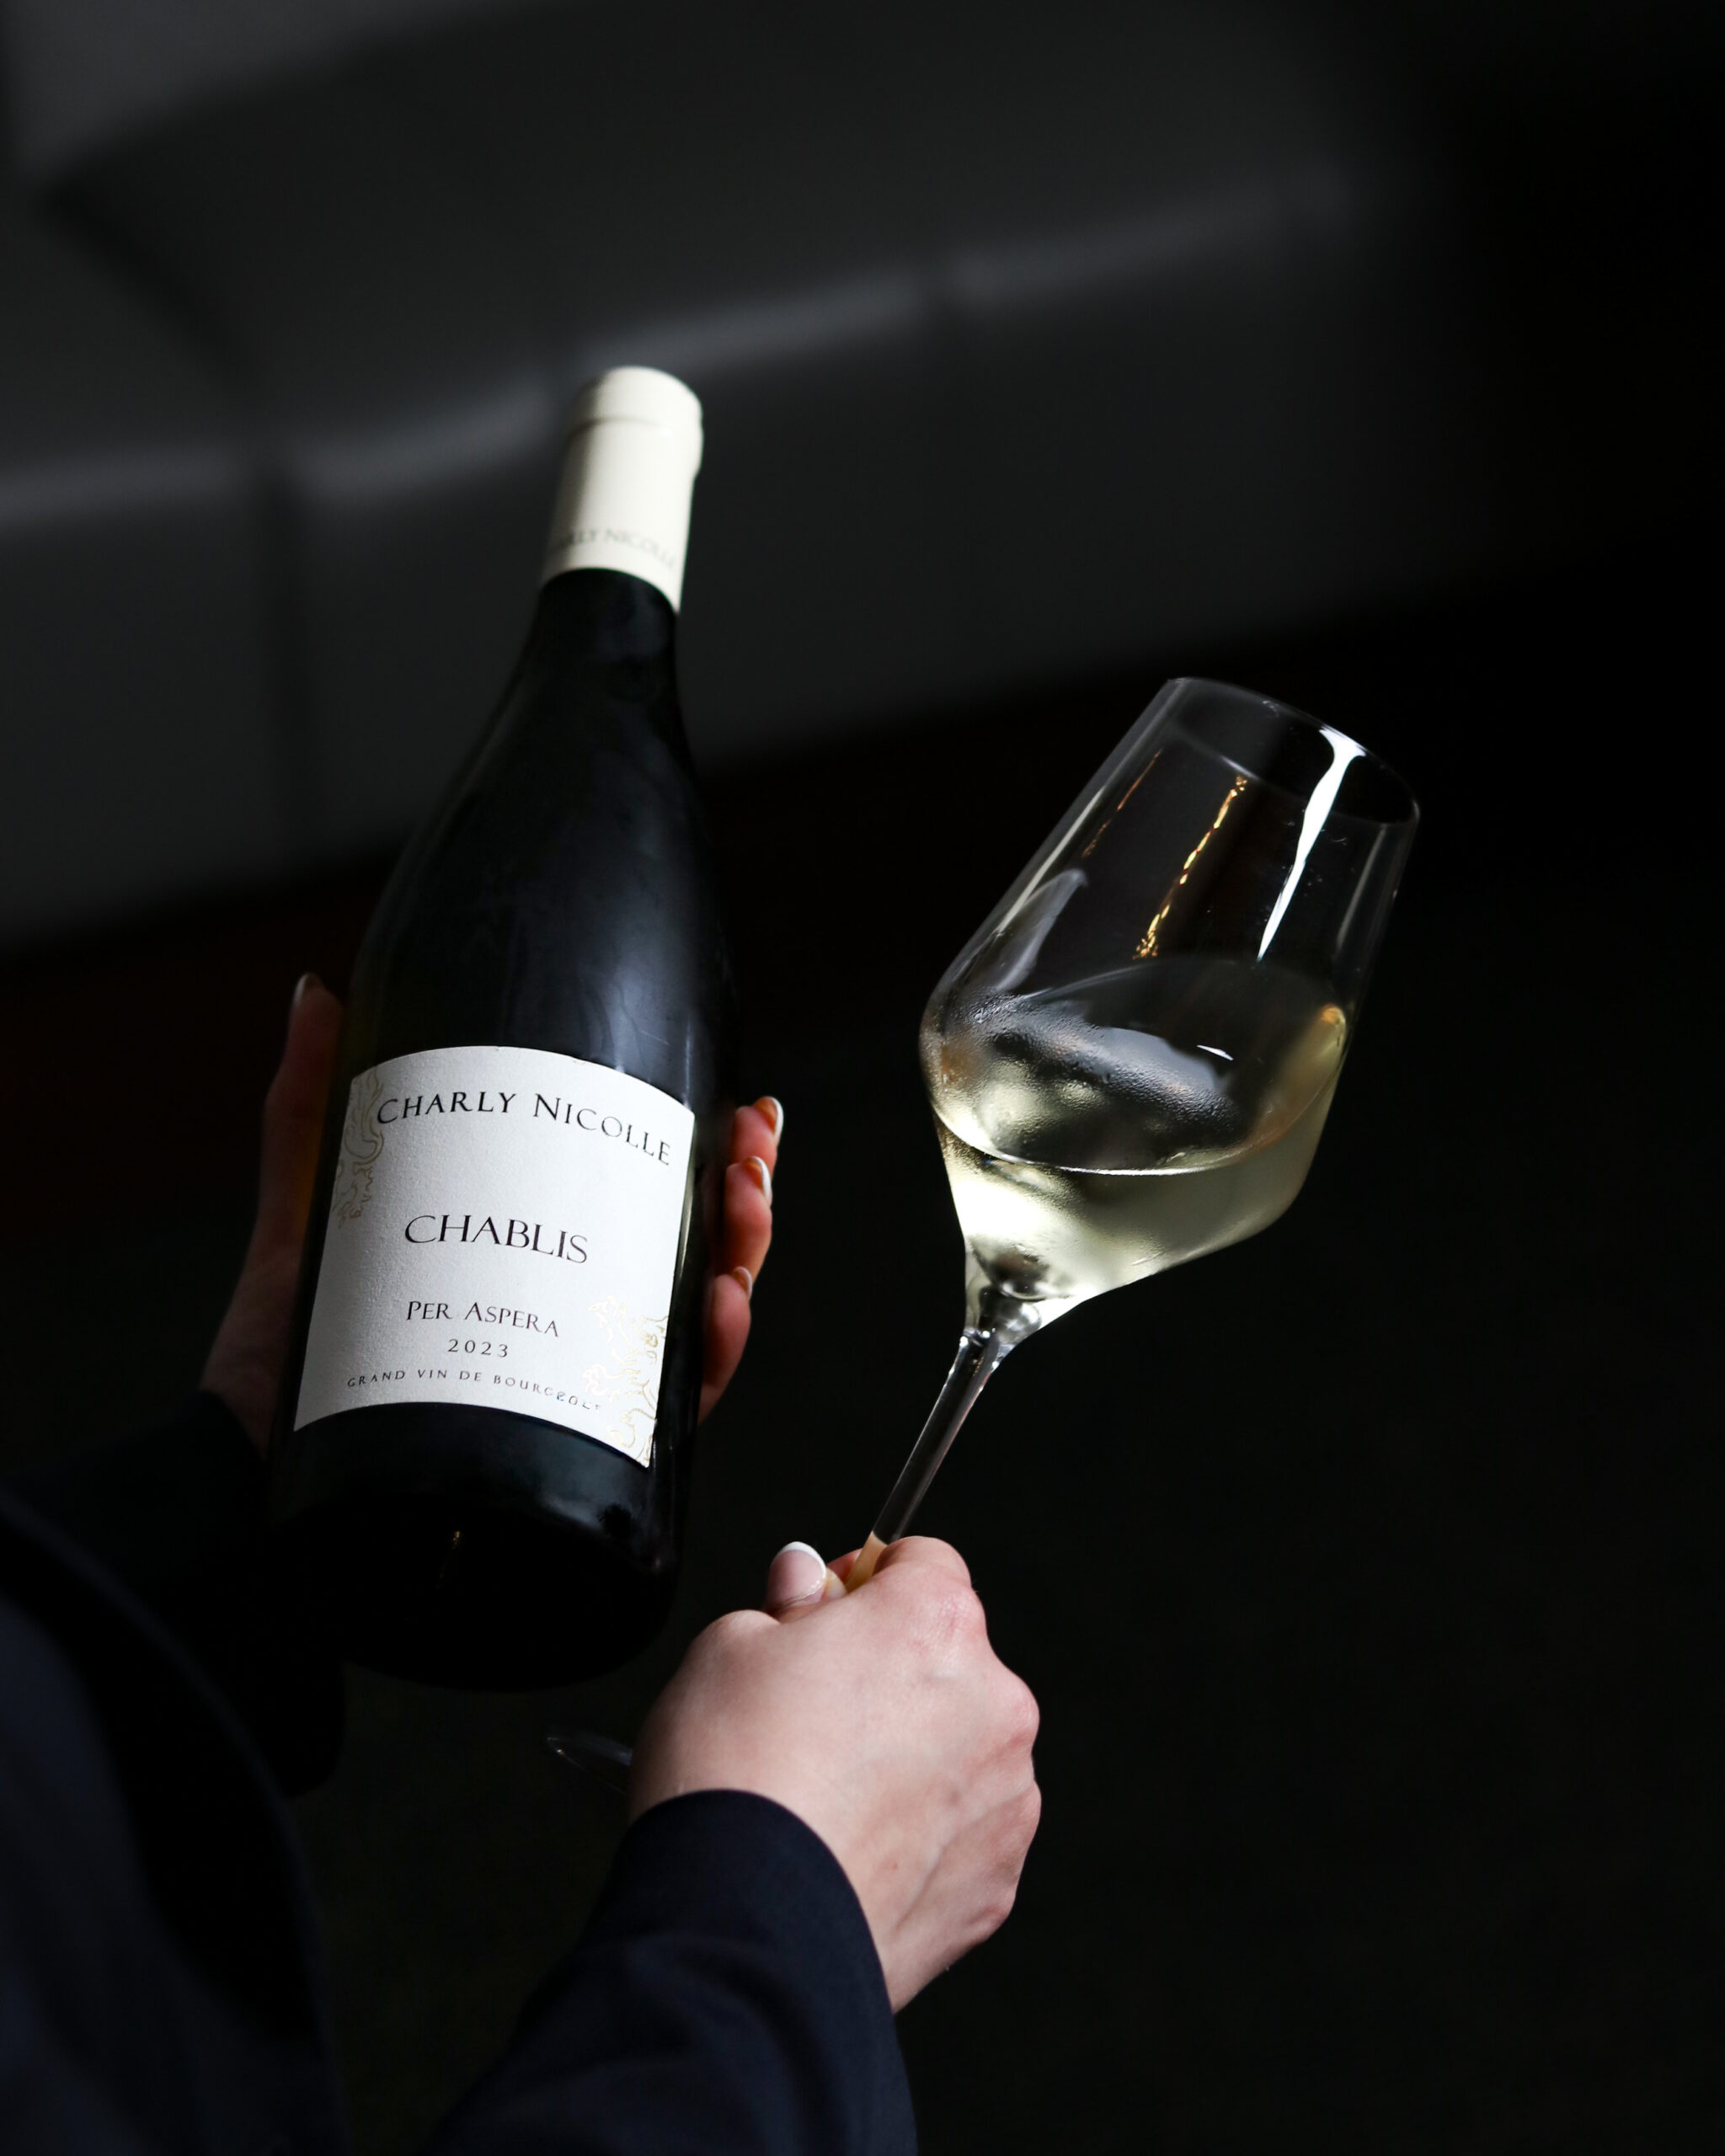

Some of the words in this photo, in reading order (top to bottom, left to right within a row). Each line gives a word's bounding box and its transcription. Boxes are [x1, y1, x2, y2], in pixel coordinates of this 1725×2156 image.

[377, 1091, 516, 1124] CHARLY
[533, 1092, 671, 1166] NICOLLE
[404, 1214, 588, 1264] CHABLIS
[407, 1300, 452, 1321] PER
[464, 1301, 559, 1337] ASPERA
[447, 1338, 509, 1358] 2023
[347, 1369, 406, 1388] GRAND
[417, 1369, 448, 1380] VIN
[459, 1370, 483, 1382] DE
